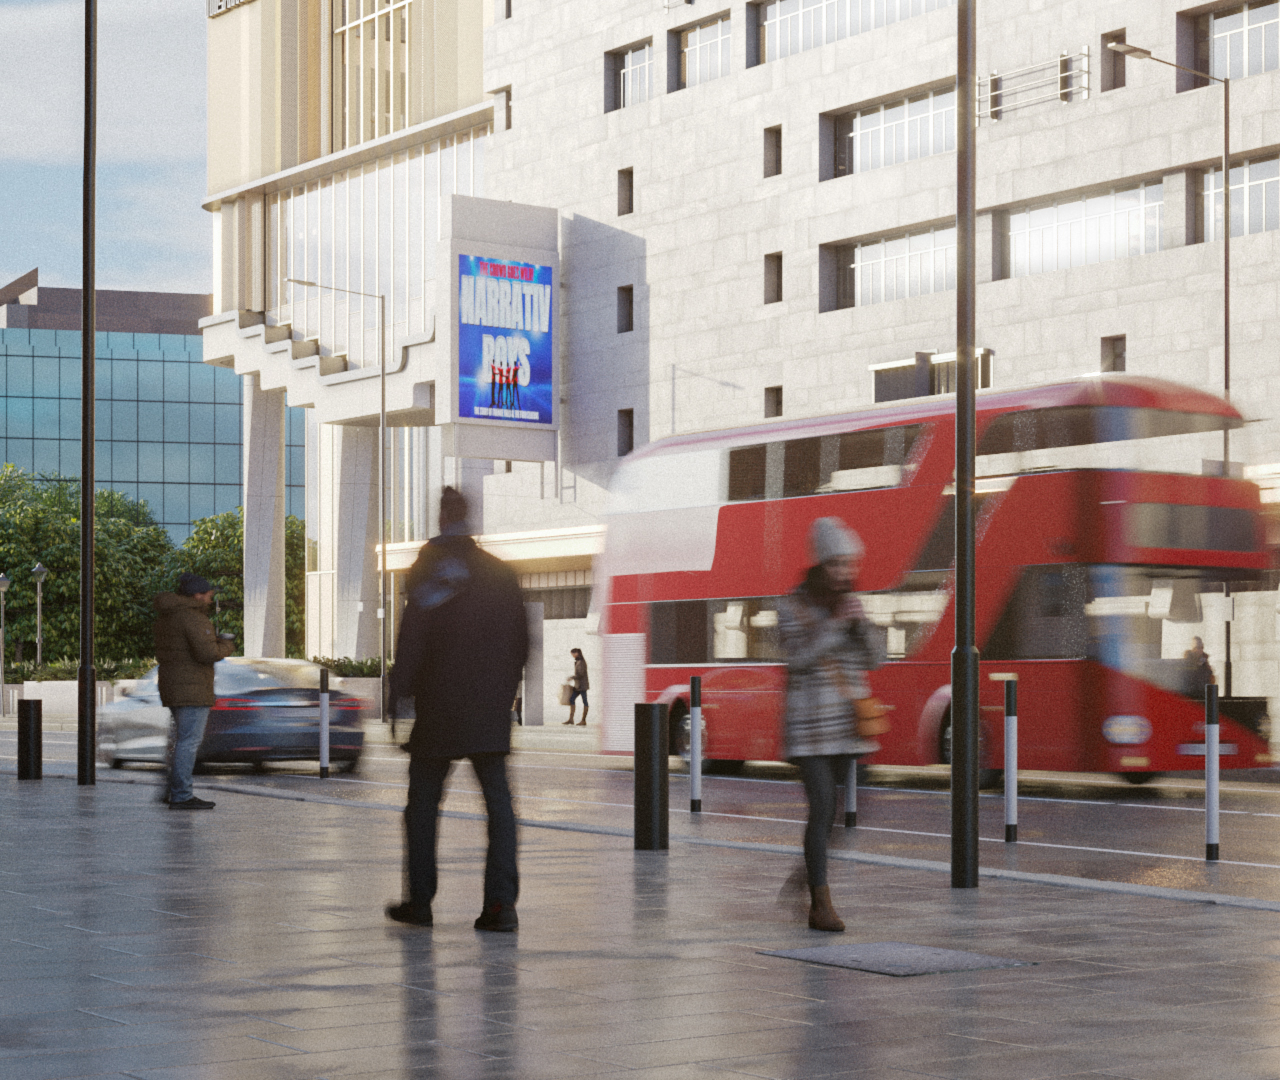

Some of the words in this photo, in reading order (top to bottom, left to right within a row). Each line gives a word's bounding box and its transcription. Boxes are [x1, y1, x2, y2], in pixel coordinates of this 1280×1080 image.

[479, 261, 489, 276] THE
[489, 262, 506, 278] CROWD
[507, 264, 519, 279] GOES
[461, 274, 551, 333] NARRATIV
[482, 333, 531, 387] BOYS
